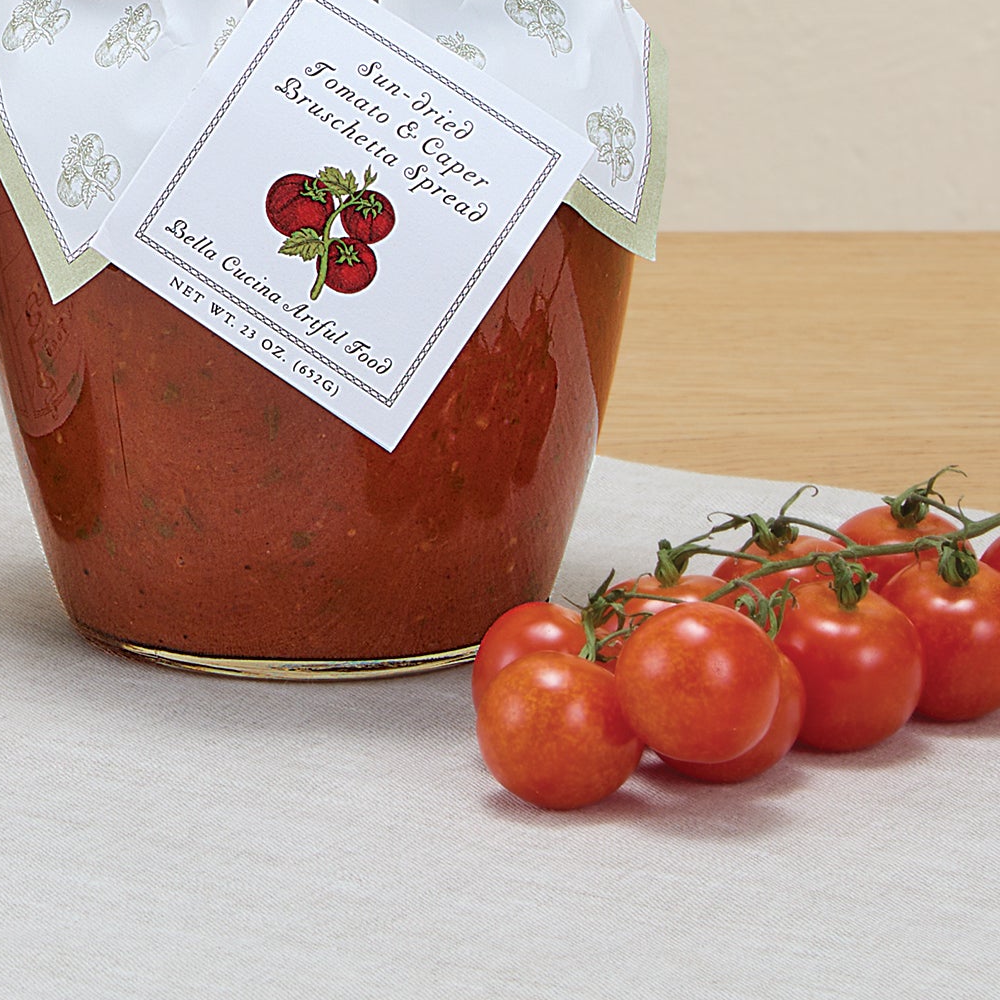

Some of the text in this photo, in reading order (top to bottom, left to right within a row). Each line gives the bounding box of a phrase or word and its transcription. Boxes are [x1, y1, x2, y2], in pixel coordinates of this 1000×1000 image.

[274, 77, 489, 224] Bruschetta Spread
[304, 61, 490, 189] Tomato & Caper
[357, 61, 475, 140] Sun-dried
[164, 218, 394, 376] Bella Cucina Artful Food
[169, 275, 340, 398] NET WT. 23 OZ. (652G)
